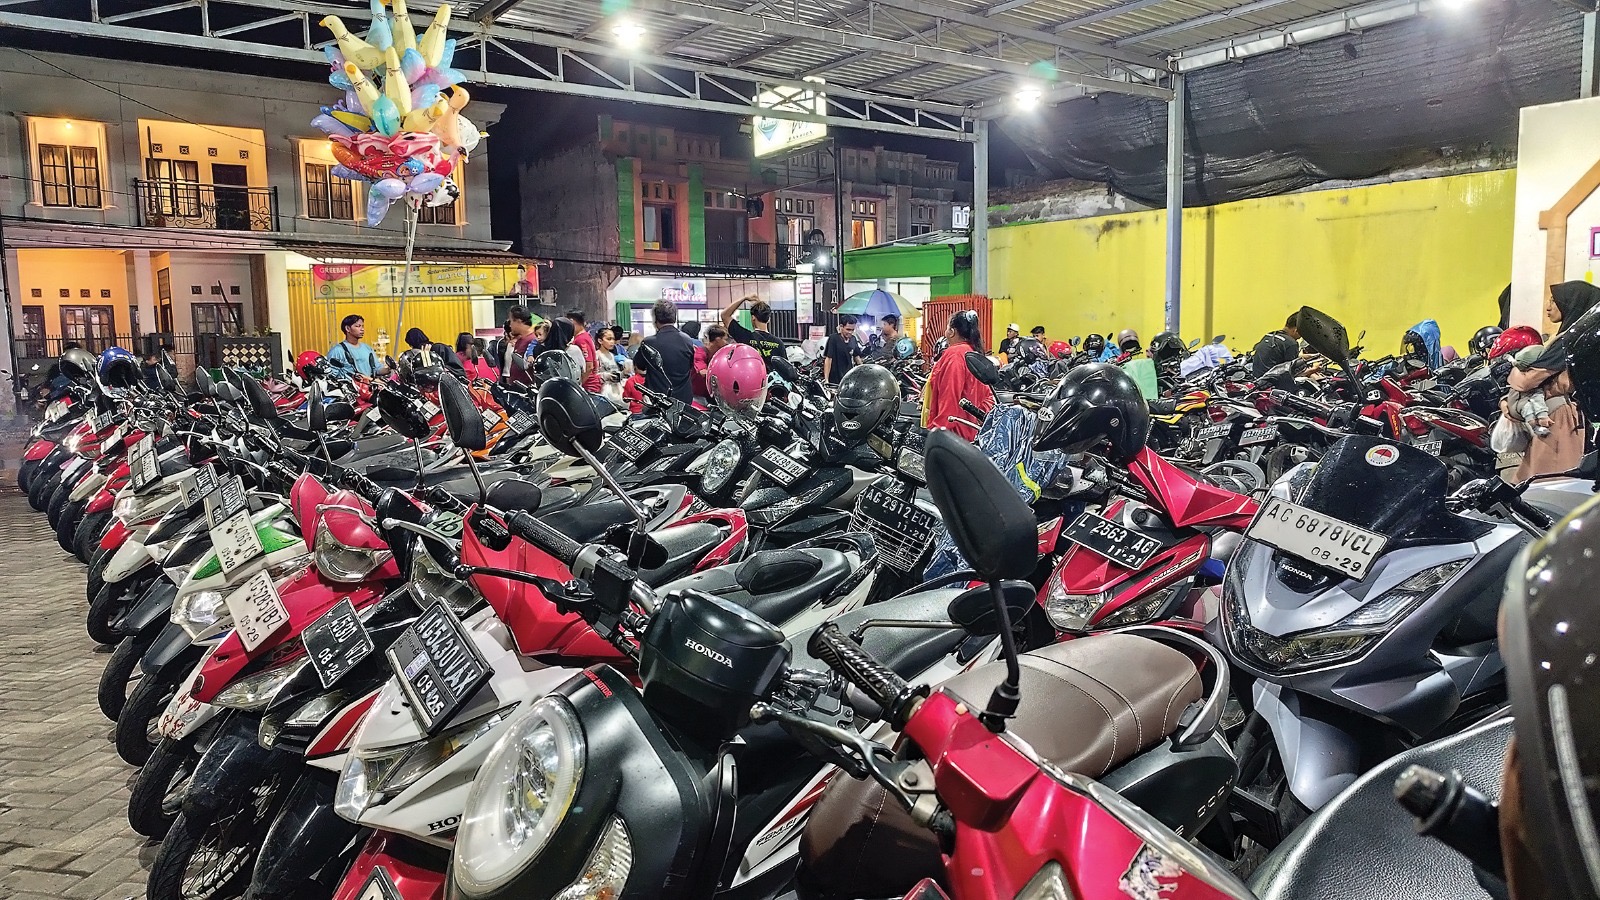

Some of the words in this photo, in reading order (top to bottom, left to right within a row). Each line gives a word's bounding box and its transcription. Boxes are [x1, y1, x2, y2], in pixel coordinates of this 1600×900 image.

[1078, 515, 1089, 528] L
[1091, 521, 1128, 543] 2563
[1281, 563, 1313, 581] HONDA
[684, 638, 733, 669] HONDA
